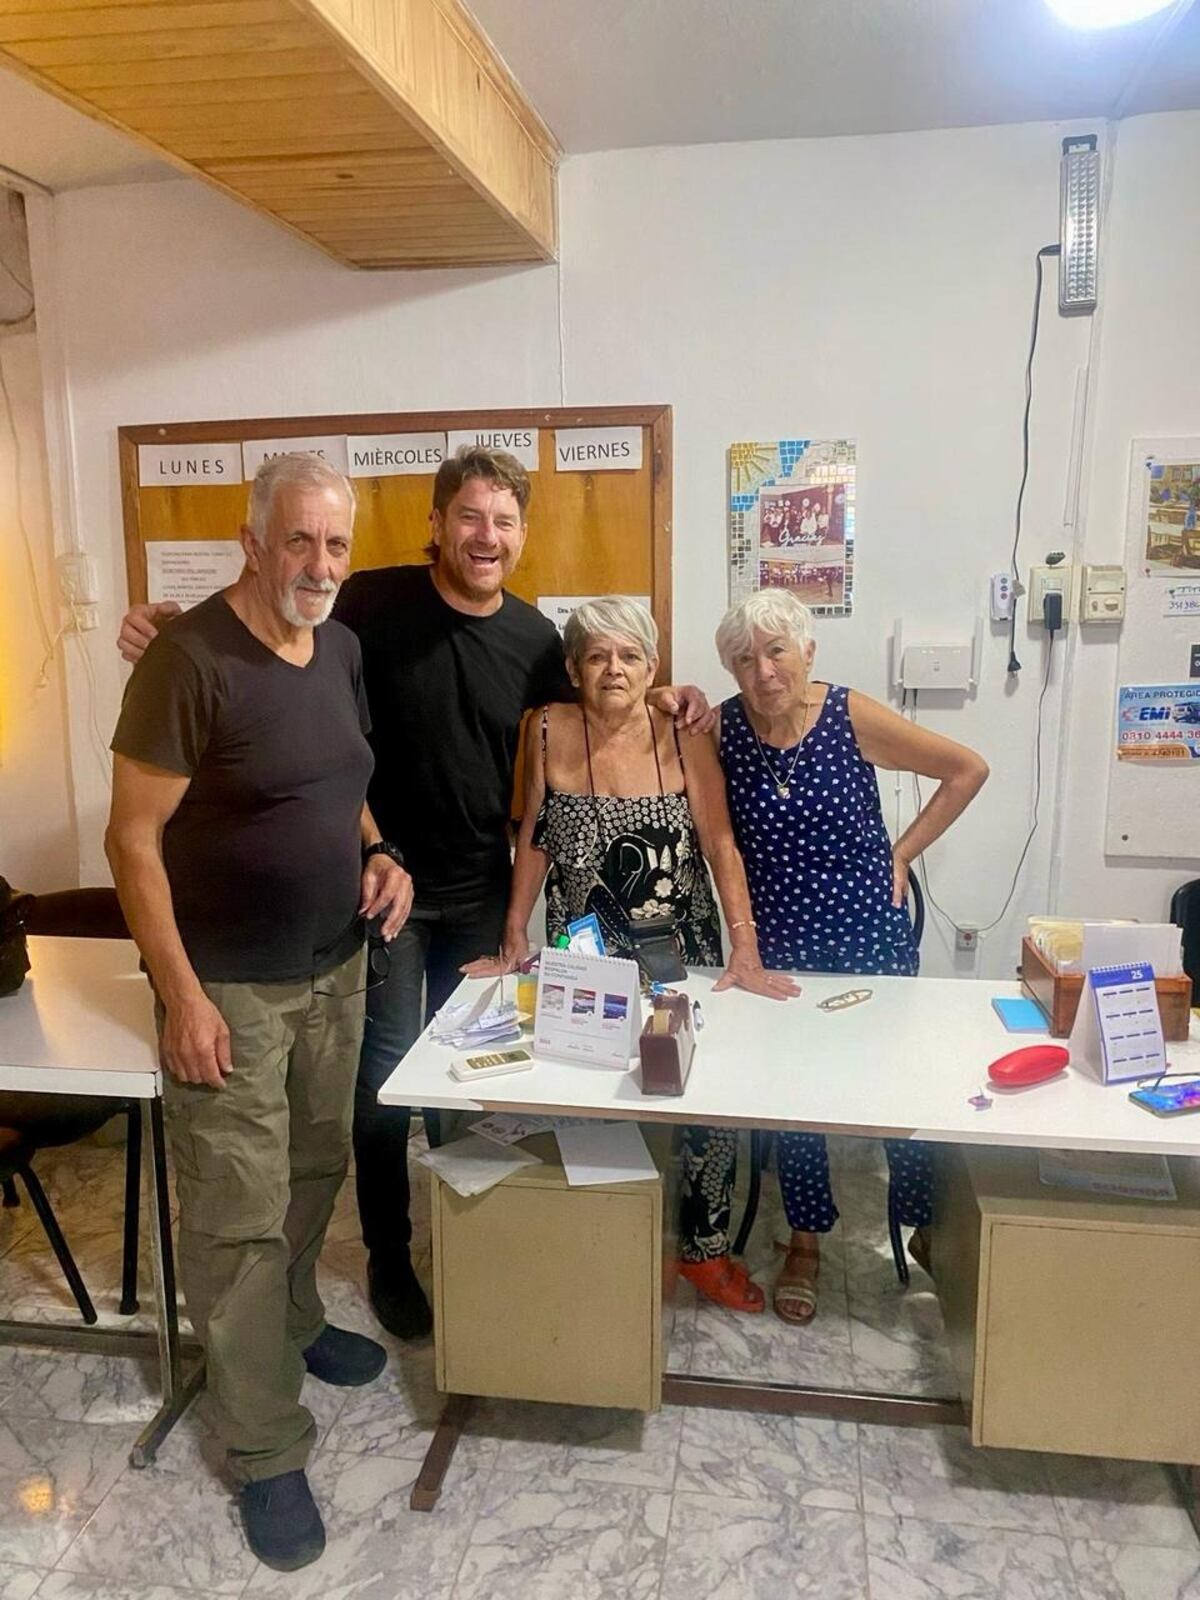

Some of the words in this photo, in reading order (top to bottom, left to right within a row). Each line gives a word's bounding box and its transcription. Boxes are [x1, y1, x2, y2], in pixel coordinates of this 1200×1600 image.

[475, 432, 532, 448] JUEVES
[354, 448, 442, 467] MIÈRCOLES
[560, 441, 630, 462] VIERNES
[160, 459, 225, 475] LUNES
[1131, 970, 1144, 980] 25
